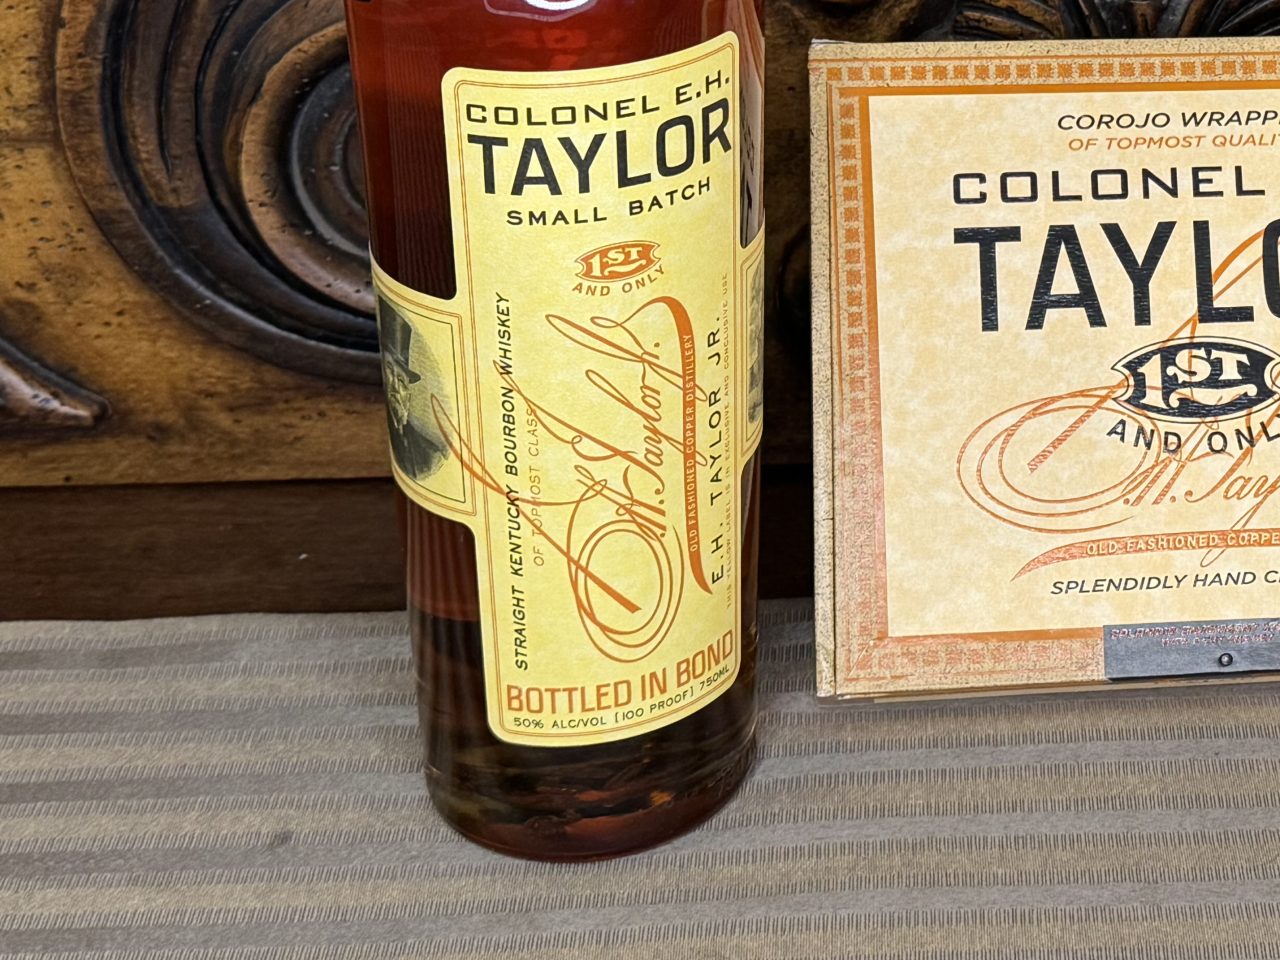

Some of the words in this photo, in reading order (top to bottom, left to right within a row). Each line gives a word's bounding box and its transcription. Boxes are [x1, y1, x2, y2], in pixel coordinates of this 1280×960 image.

[466, 94, 660, 126] COLONEL
[675, 69, 730, 106] E.H.
[1056, 111, 1170, 132] COROJO
[467, 97, 733, 197] TAYLOR
[1068, 135, 1100, 152] OF
[1105, 133, 1206, 151] TOPMOST
[507, 206, 608, 227] SMALL
[628, 176, 712, 217] BATCH
[953, 164, 1266, 205] COLONEL
[571, 282, 611, 297] AND
[621, 263, 666, 294] ONLY
[586, 245, 646, 280] 1ST
[496, 291, 513, 376] WHISKEY
[706, 315, 721, 367] JR.
[721, 301, 730, 371] CONCLUSIVE
[682, 334, 696, 402] DISTILLERY
[1139, 345, 1251, 410] 1ST
[501, 386, 519, 476] BOURBON
[525, 406, 540, 457] CLASS
[684, 406, 696, 453] COPPER
[708, 386, 724, 506] TAYLOR
[723, 400, 731, 462] EXCLUSIVE
[1106, 418, 1182, 455] AND
[529, 465, 543, 538] TOPMOST
[685, 459, 698, 525] FASHIONED
[505, 484, 524, 578] KENTUCKY
[532, 545, 545, 567] OF
[688, 529, 700, 552] OLD
[710, 522, 725, 584] E.H.
[1085, 538, 1119, 557] OLD
[1125, 534, 1220, 553] FASHIONED
[725, 583, 733, 609] THIS
[1050, 573, 1189, 596] SPLENDIDLY
[1192, 570, 1257, 588] HAND
[512, 585, 528, 671] STRAIGHT
[506, 678, 632, 715] BOTTLED
[640, 667, 668, 701] IN
[676, 628, 734, 689] BOND
[513, 716, 545, 730] 50%
[551, 714, 608, 730] ALC/VOL
[698, 662, 731, 692] 750ML
